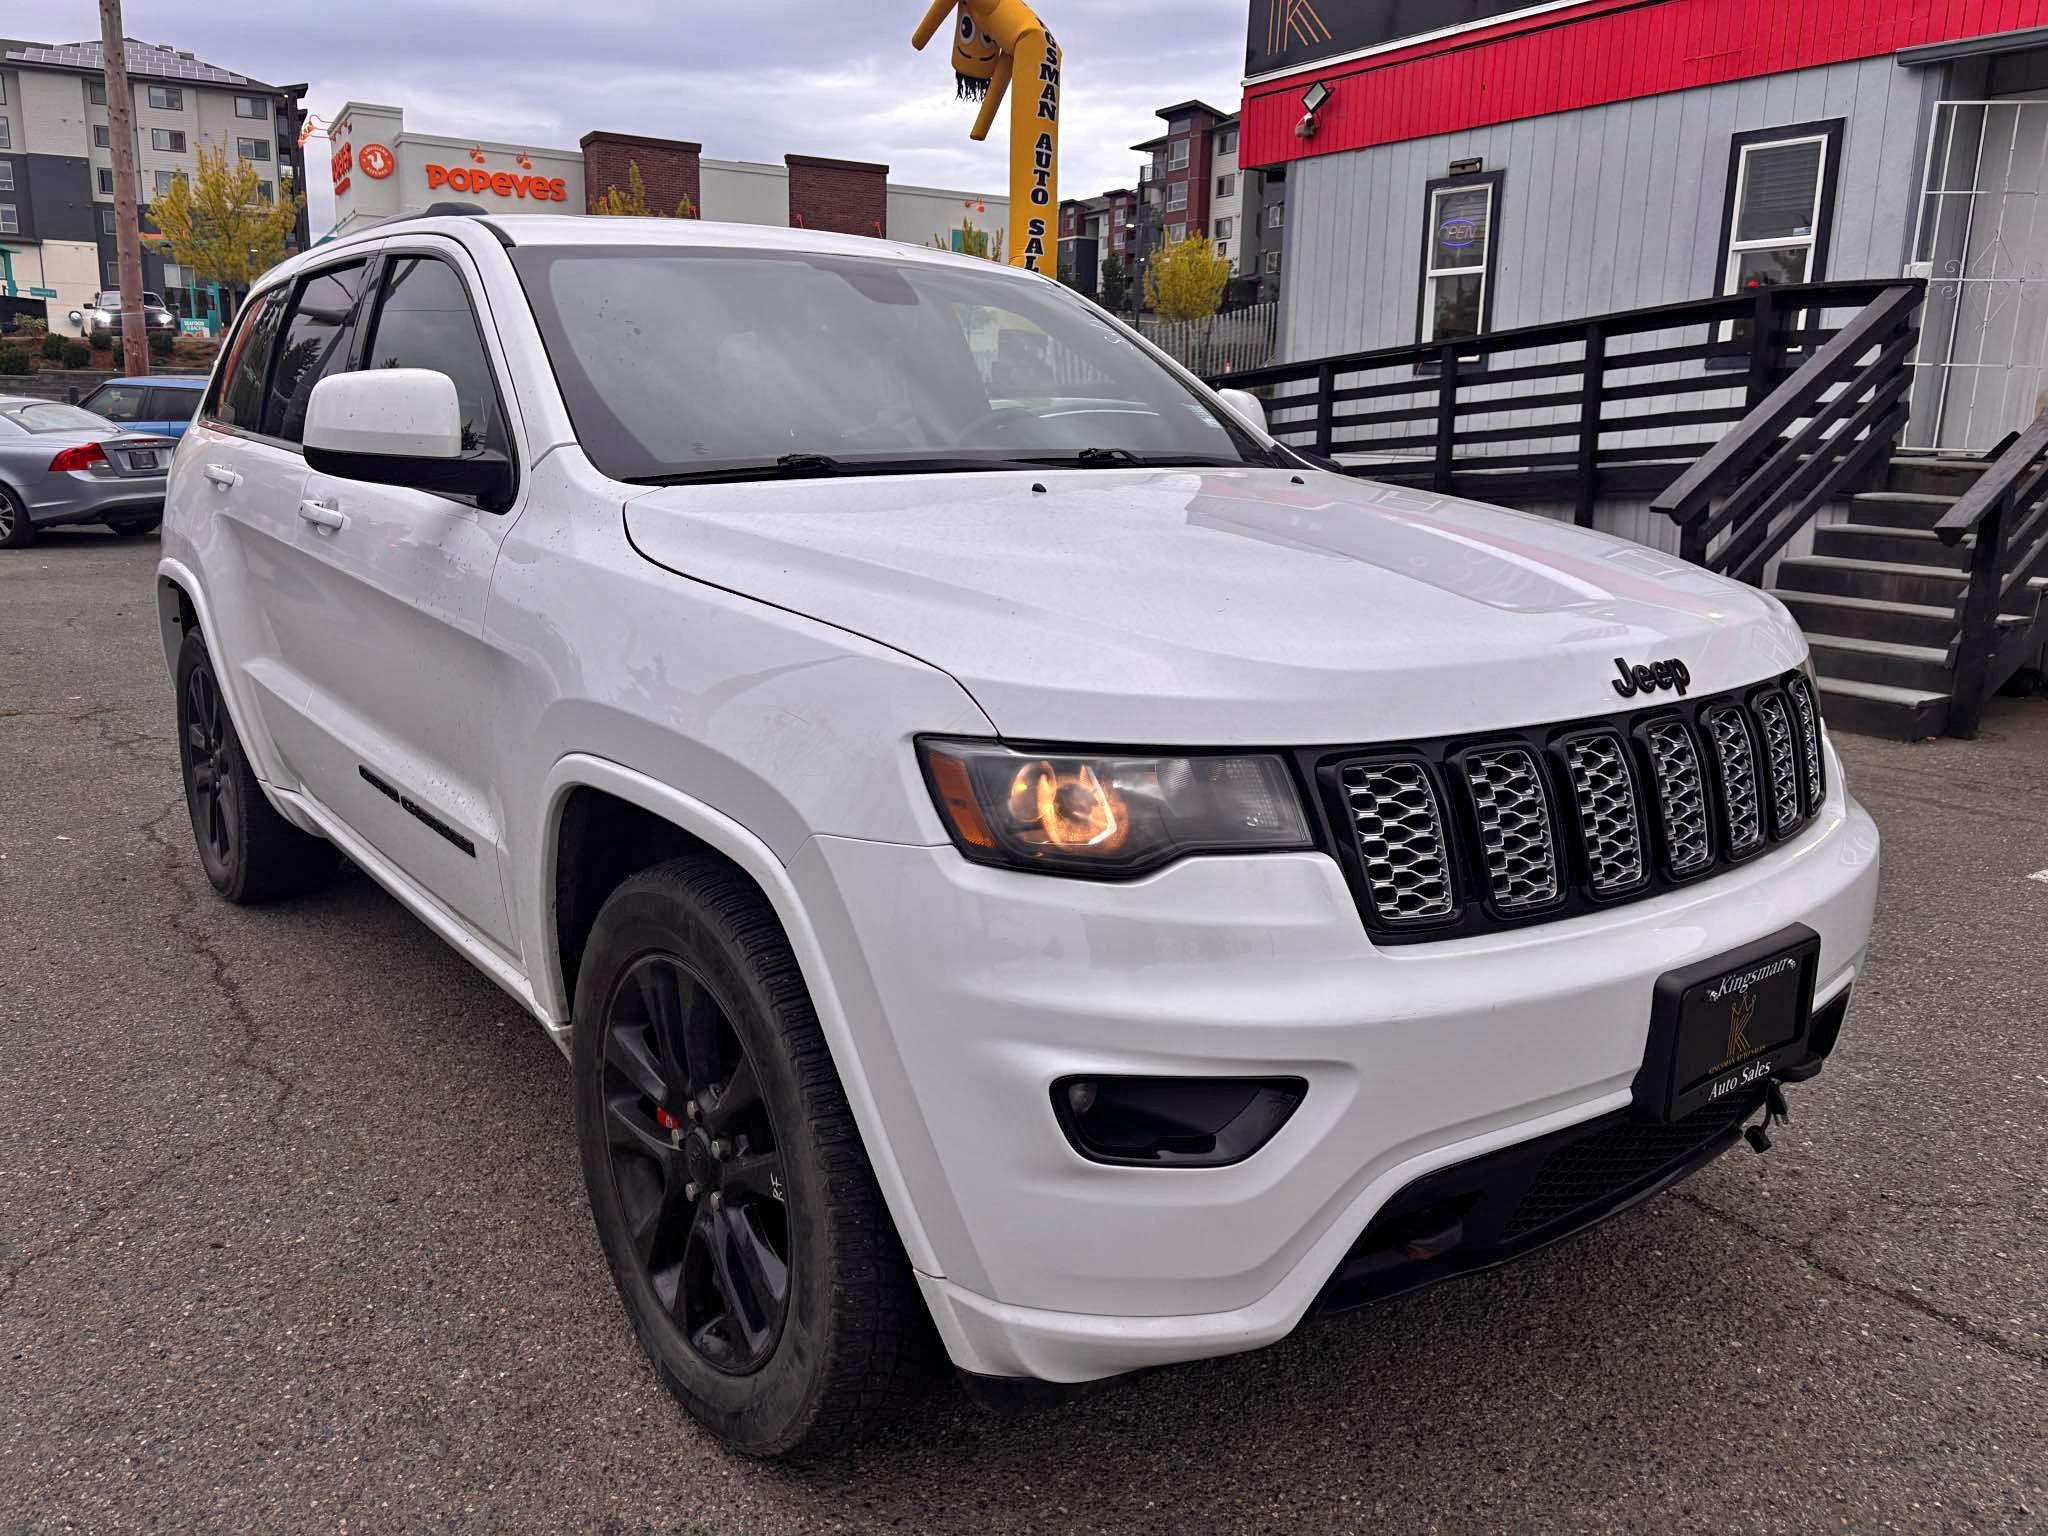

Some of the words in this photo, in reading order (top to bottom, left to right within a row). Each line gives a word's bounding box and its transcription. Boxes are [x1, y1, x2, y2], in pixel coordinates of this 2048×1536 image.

[1030, 132, 1052, 205] AUTO
[1612, 657, 1690, 698] Jeep
[1718, 957, 1789, 994] Kingsman
[1708, 1077, 1738, 1101] Auto
[1740, 1060, 1771, 1085] Sales
